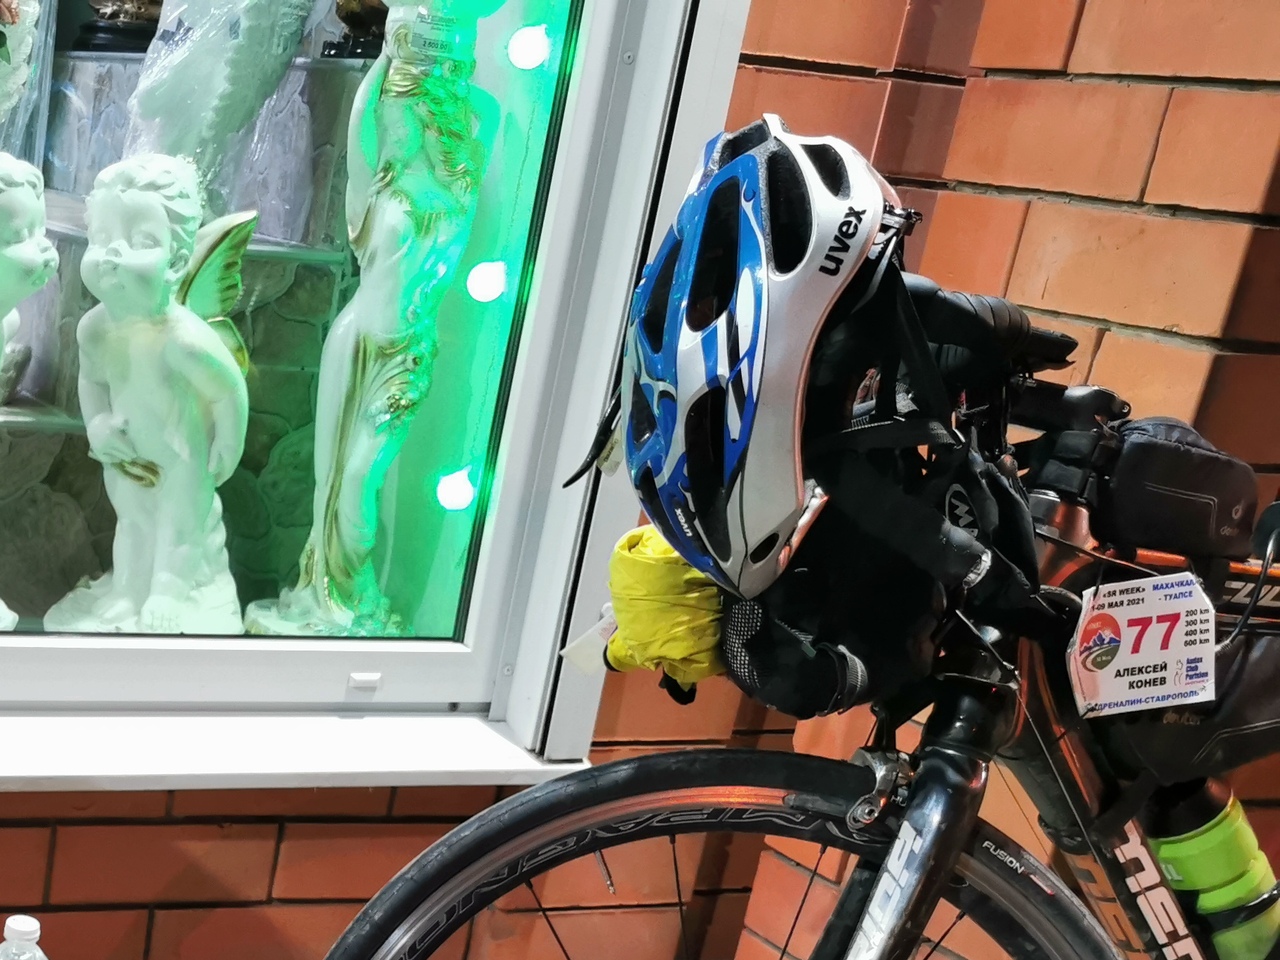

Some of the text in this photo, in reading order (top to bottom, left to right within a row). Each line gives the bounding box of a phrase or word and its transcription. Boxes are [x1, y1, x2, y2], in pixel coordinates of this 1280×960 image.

[818, 206, 867, 277] uvex
[674, 507, 693, 537] uvex
[1152, 579, 1196, 591] МАХАЧКАЛ
[1164, 590, 1193, 602] ТУАПСЕ
[1108, 599, 1124, 610] МАЯ
[1126, 597, 1145, 607] 2021
[1185, 609, 1198, 617] 200
[1185, 619, 1198, 627] 300
[1127, 612, 1181, 655] 77
[1184, 629, 1198, 637] 400
[1114, 661, 1168, 679] АЛЕКСЕЙ
[1128, 676, 1167, 690] КОНЕВ
[1096, 690, 1200, 711] ДРЕНАЛИН-СТАВРОПОЛЬ
[981, 839, 1025, 875] FUSION
